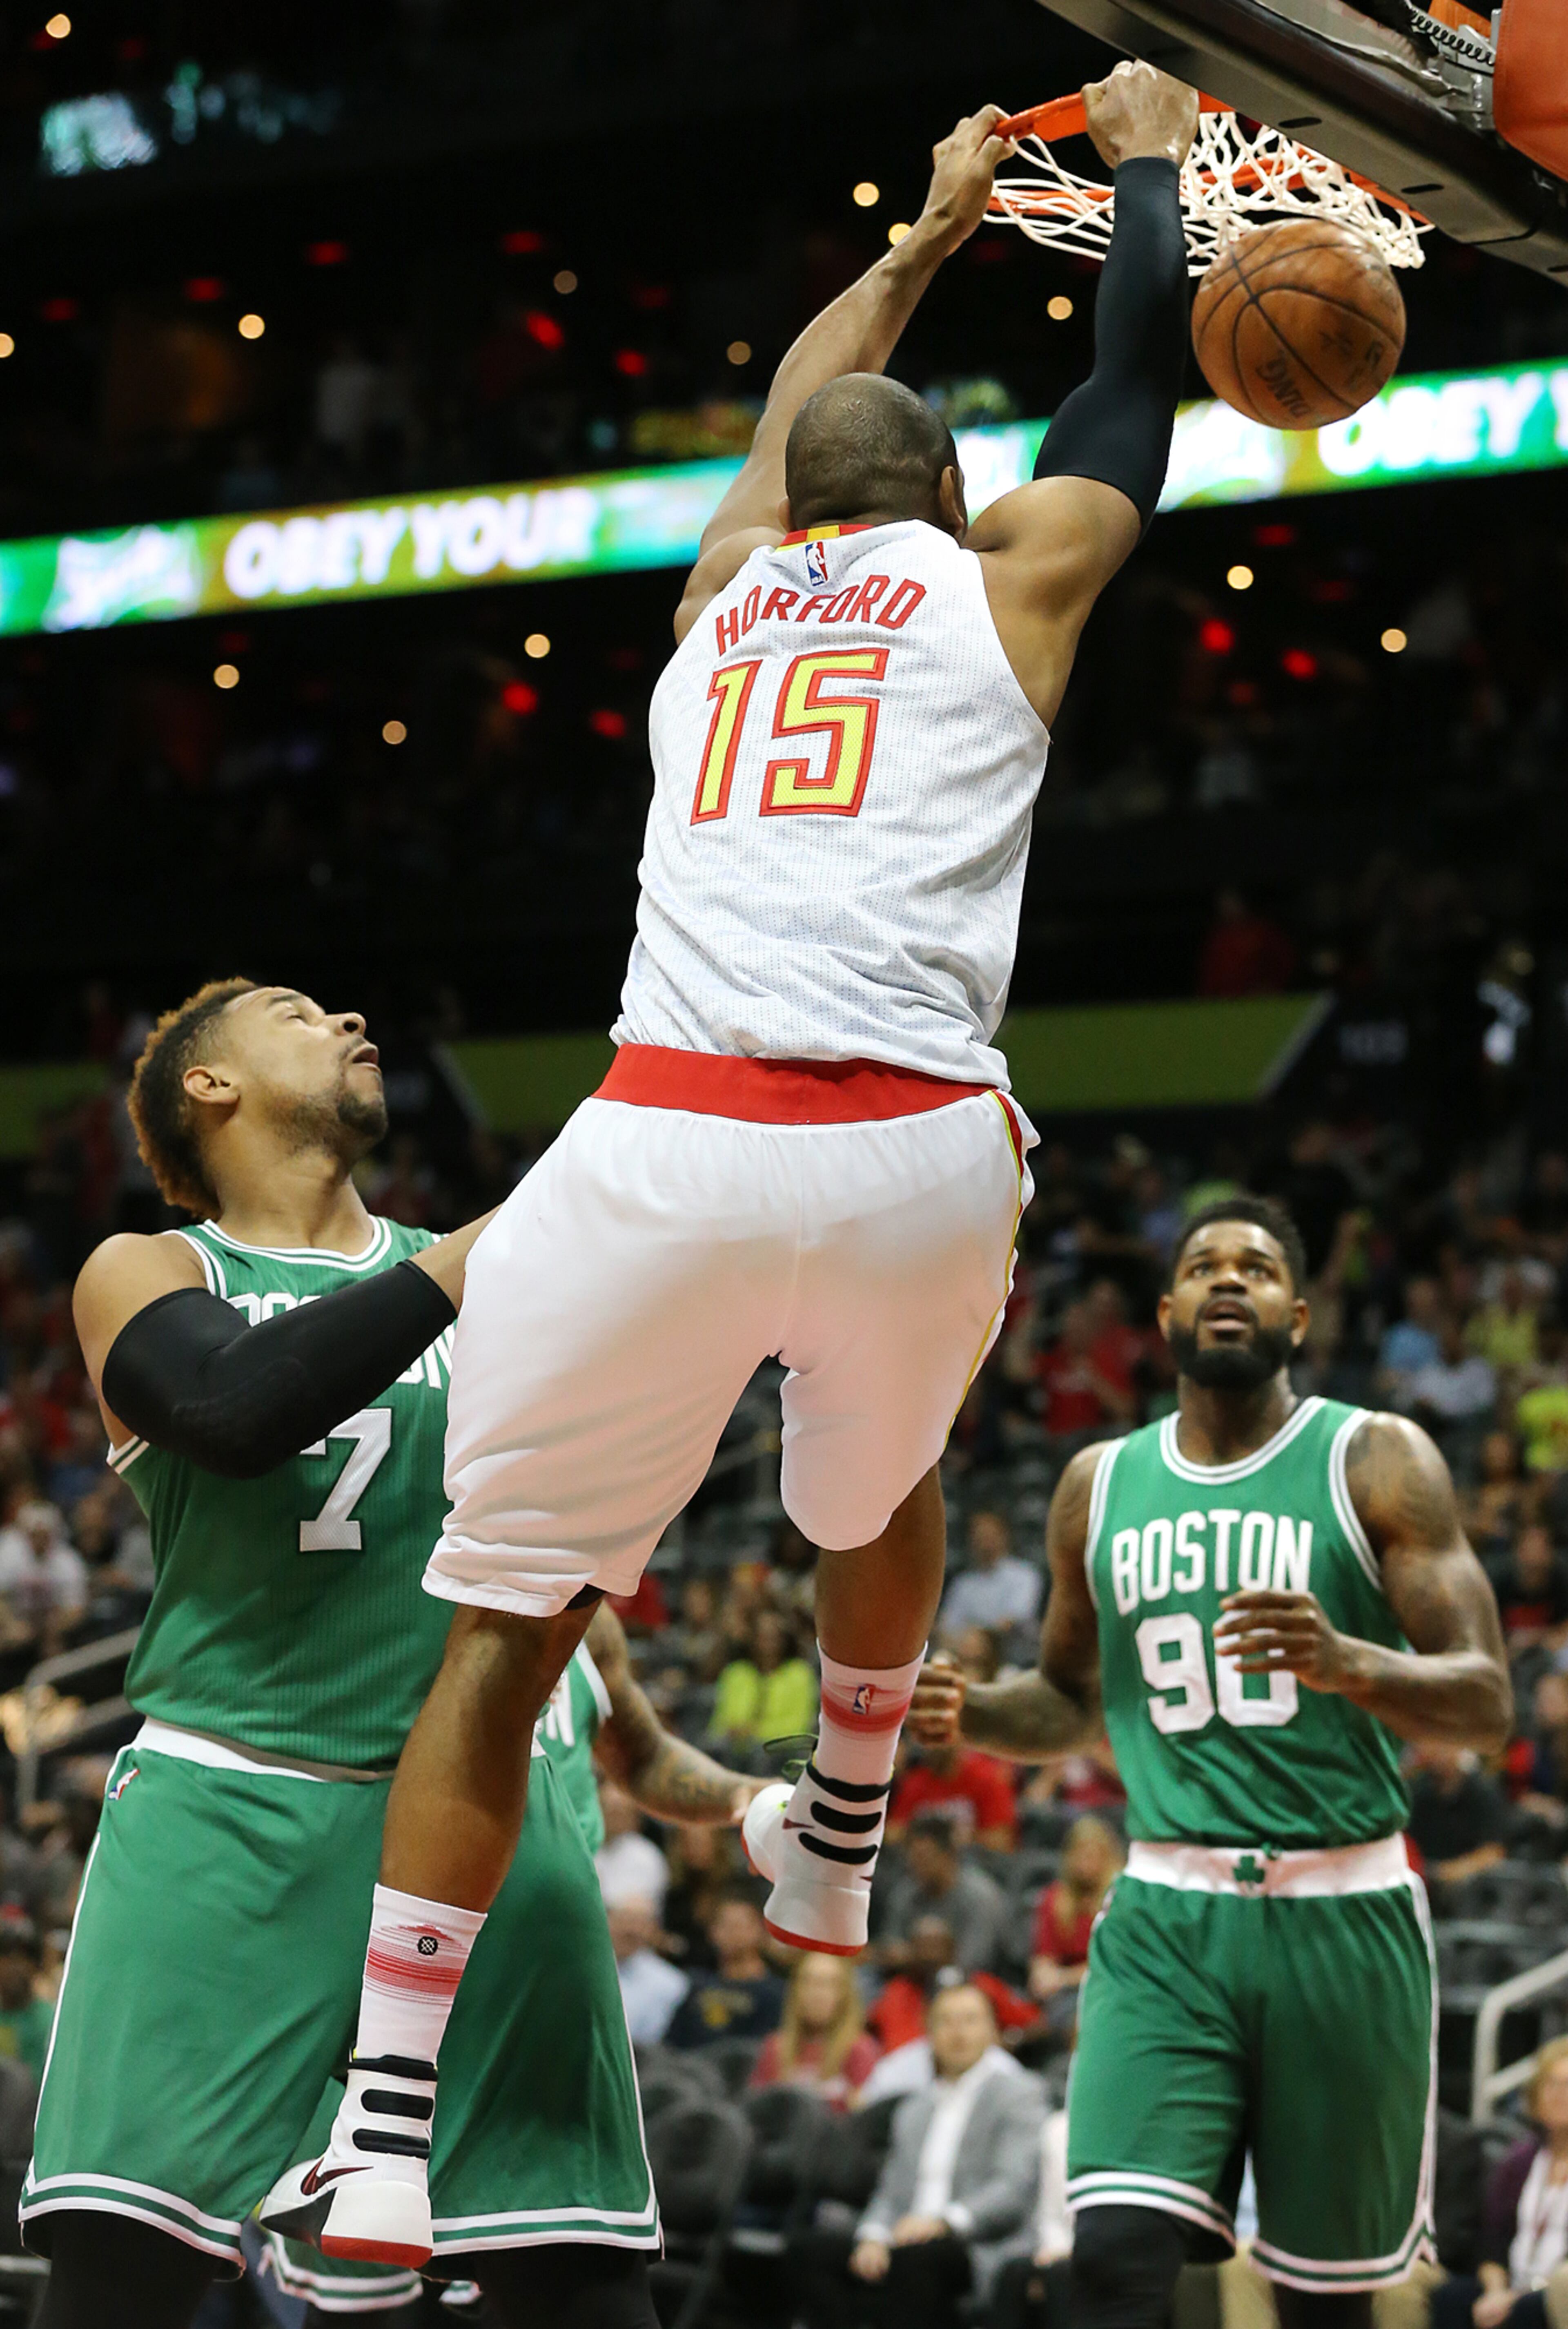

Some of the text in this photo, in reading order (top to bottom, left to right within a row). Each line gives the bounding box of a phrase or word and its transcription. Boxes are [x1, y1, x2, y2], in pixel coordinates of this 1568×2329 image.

[1317, 371, 1544, 478] OBEY
[224, 506, 408, 600] OBEY
[410, 487, 598, 580] YOUR
[715, 574, 927, 655] HORFORD
[689, 648, 891, 827] 15
[299, 1407, 392, 1552] 7
[1111, 1508, 1314, 1617] BOSTON
[1134, 1612, 1299, 1734] 90
